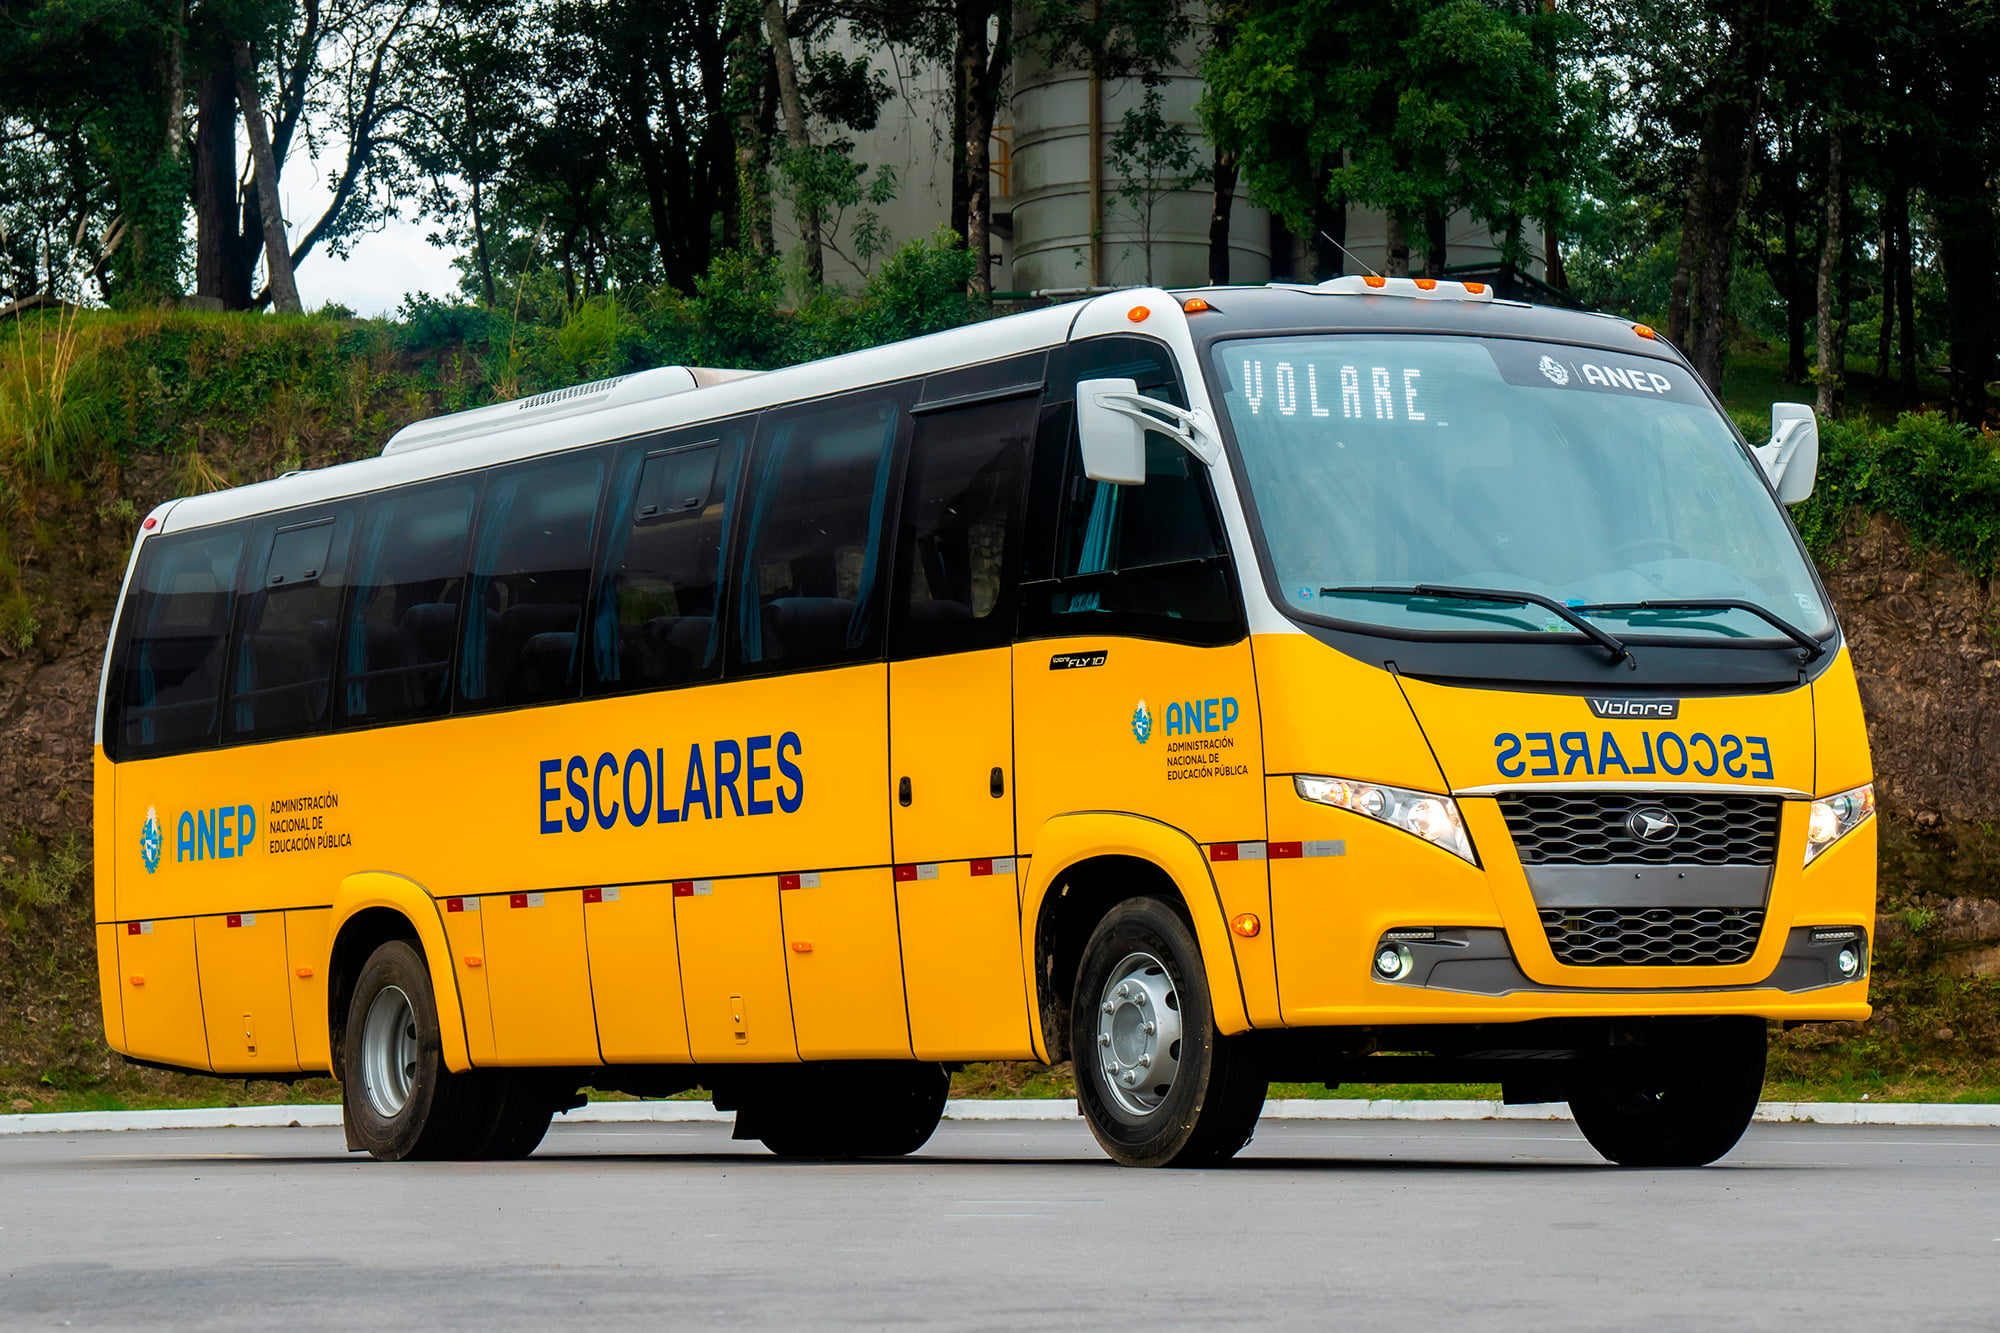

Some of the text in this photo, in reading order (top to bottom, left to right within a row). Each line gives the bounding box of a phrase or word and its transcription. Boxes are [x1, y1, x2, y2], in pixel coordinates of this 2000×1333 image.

[1243, 360, 1426, 420] VOLARE
[1582, 363, 1672, 394] ANEP
[1067, 657, 1090, 668] FLY
[1091, 656, 1105, 666] 10
[1166, 697, 1239, 736] ANEP
[1593, 699, 1673, 716] Volare
[1167, 736, 1234, 753] ADMINISTRACIÓN
[1167, 753, 1220, 767] NACIONAL DE
[539, 731, 804, 835] ESCOLARES
[1167, 764, 1248, 781] EDUCACIÓN PÚBLICA
[270, 791, 339, 814] ADMINISTRACIÓN
[177, 804, 257, 863] ANEP
[269, 816, 323, 834] NACIONAL DE
[269, 831, 352, 854] EDUCACIÓN PÚBLICA
